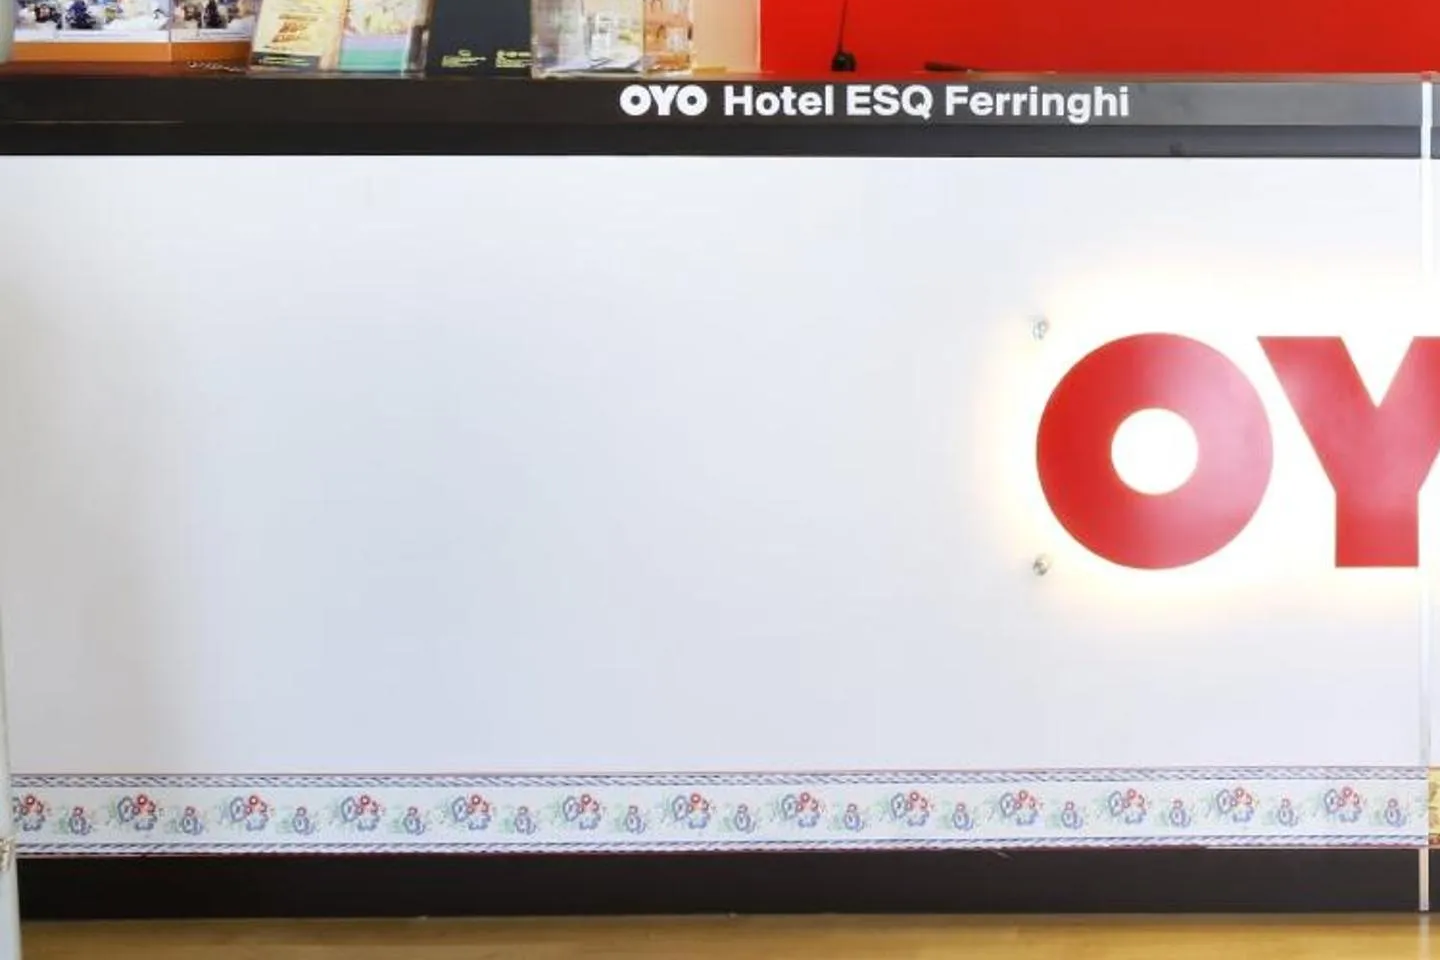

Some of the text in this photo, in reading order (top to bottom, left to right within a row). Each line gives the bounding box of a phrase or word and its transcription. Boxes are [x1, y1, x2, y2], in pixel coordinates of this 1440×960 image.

[620, 84, 1130, 124] OYO Hotel ESQ Ferringhi
